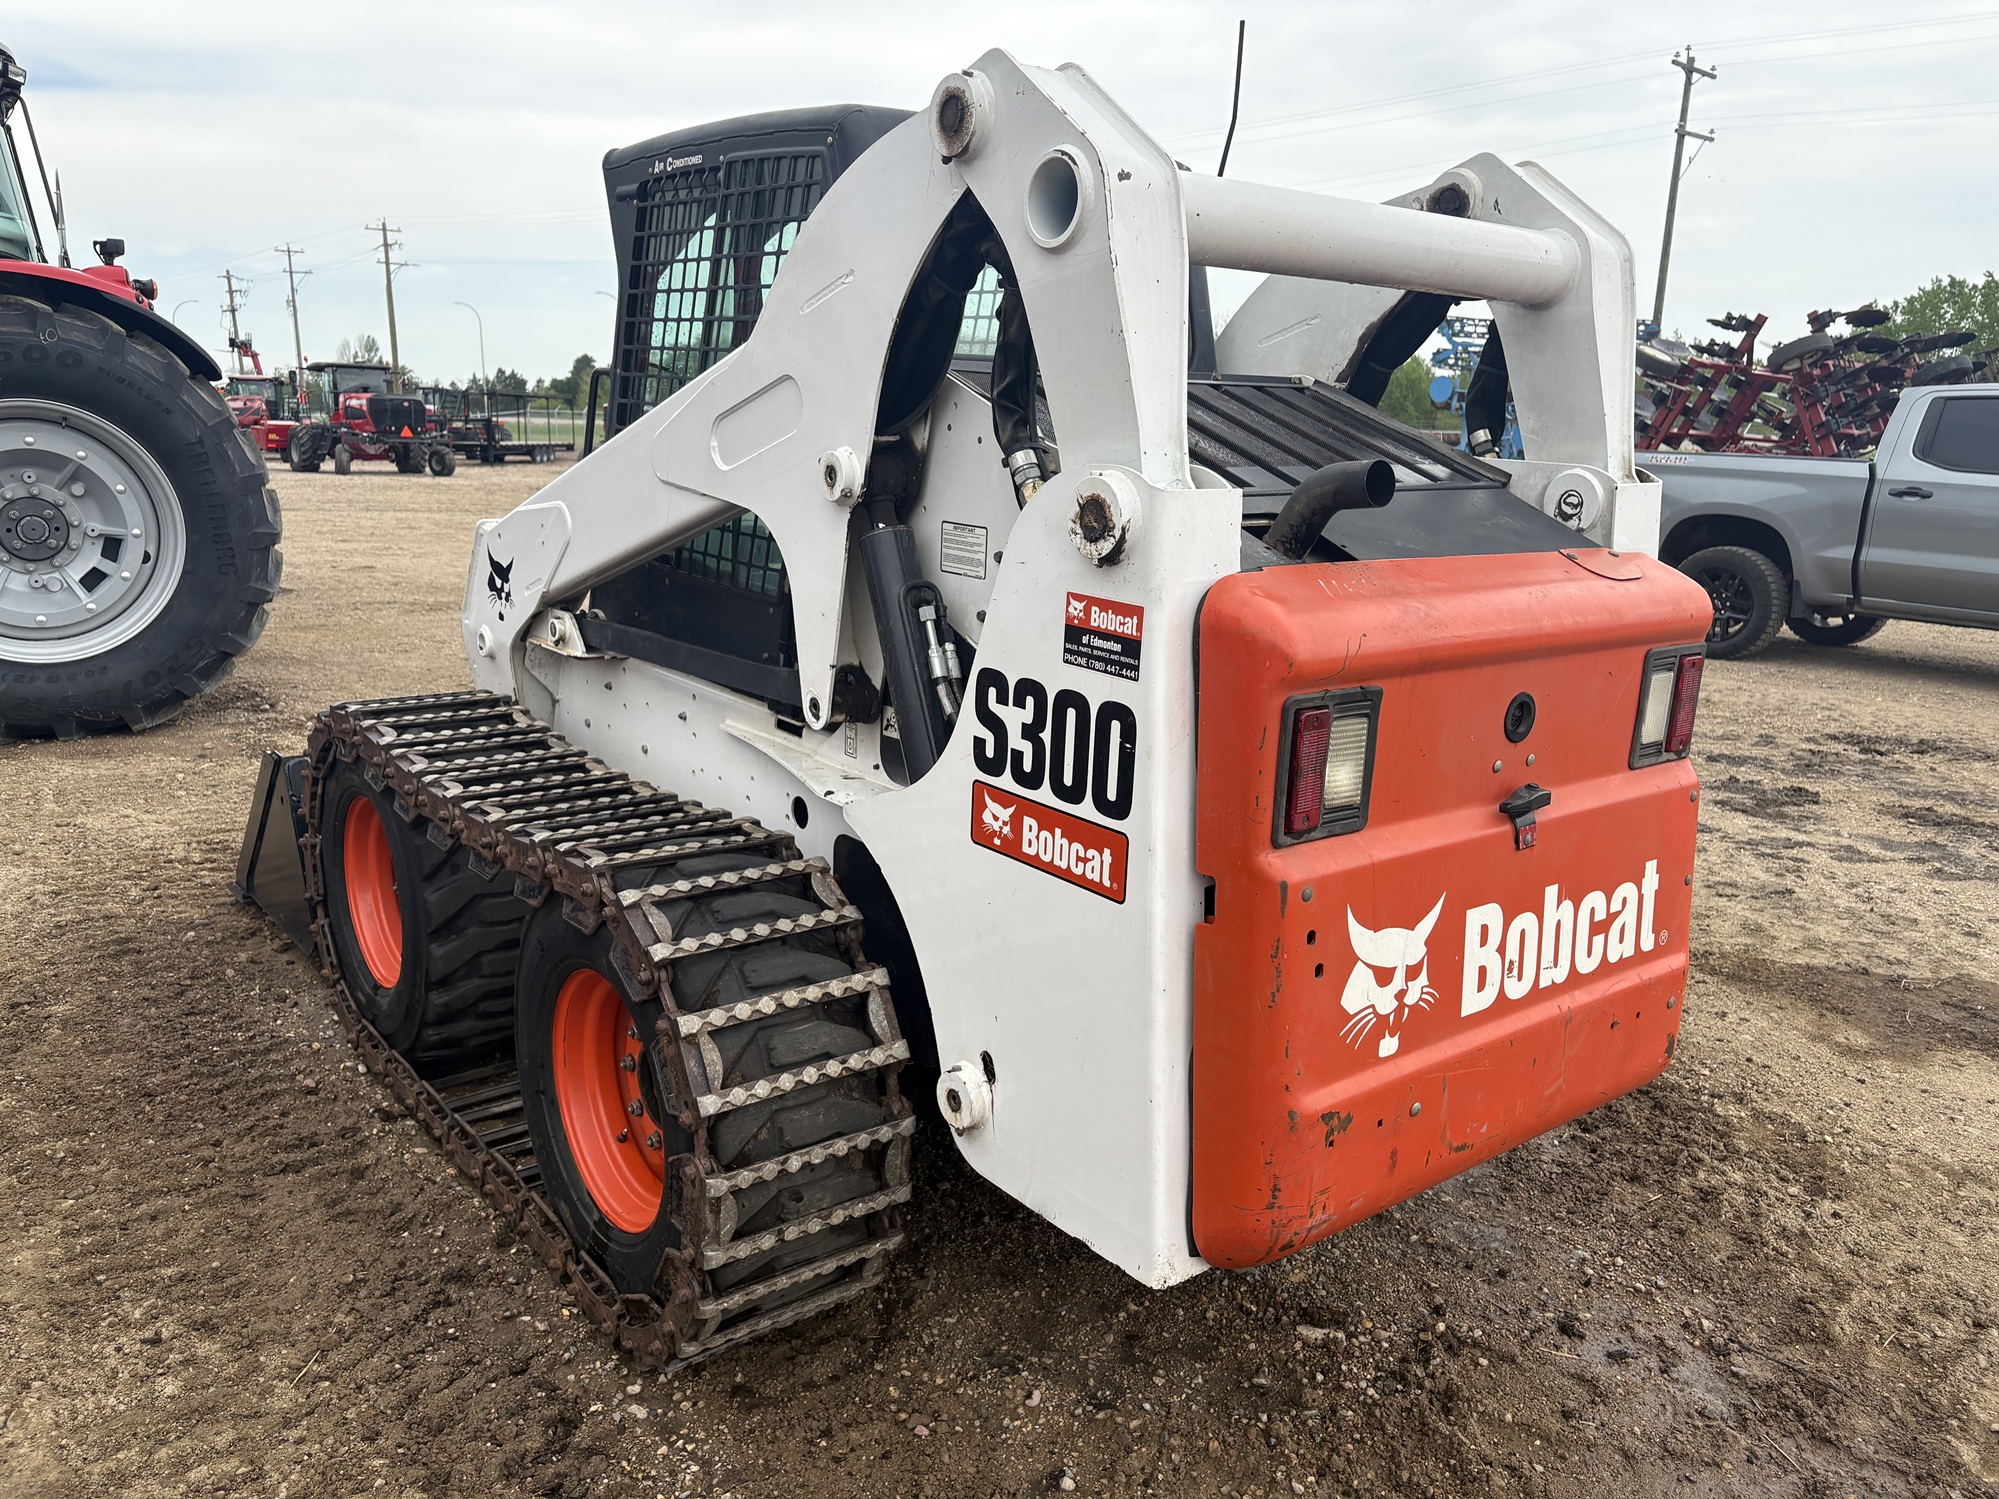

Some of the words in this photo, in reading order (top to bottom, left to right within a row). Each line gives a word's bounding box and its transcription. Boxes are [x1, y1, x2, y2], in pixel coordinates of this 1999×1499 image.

[1090, 605, 1138, 636] Bobcat
[1079, 646, 1092, 654] PARTS,
[1093, 650, 1110, 658] SERVICE
[1120, 656, 1138, 666] RENTALS
[1082, 634, 1090, 644] of
[1090, 634, 1122, 652] Edmonton
[1064, 653, 1088, 666] PHONE
[1088, 659, 1106, 670] (780)
[1106, 664, 1138, 680] 447-4441
[972, 667, 1138, 821] S300
[1021, 815, 1112, 888] Bobcat
[1461, 859, 1660, 1018] Bobcat
